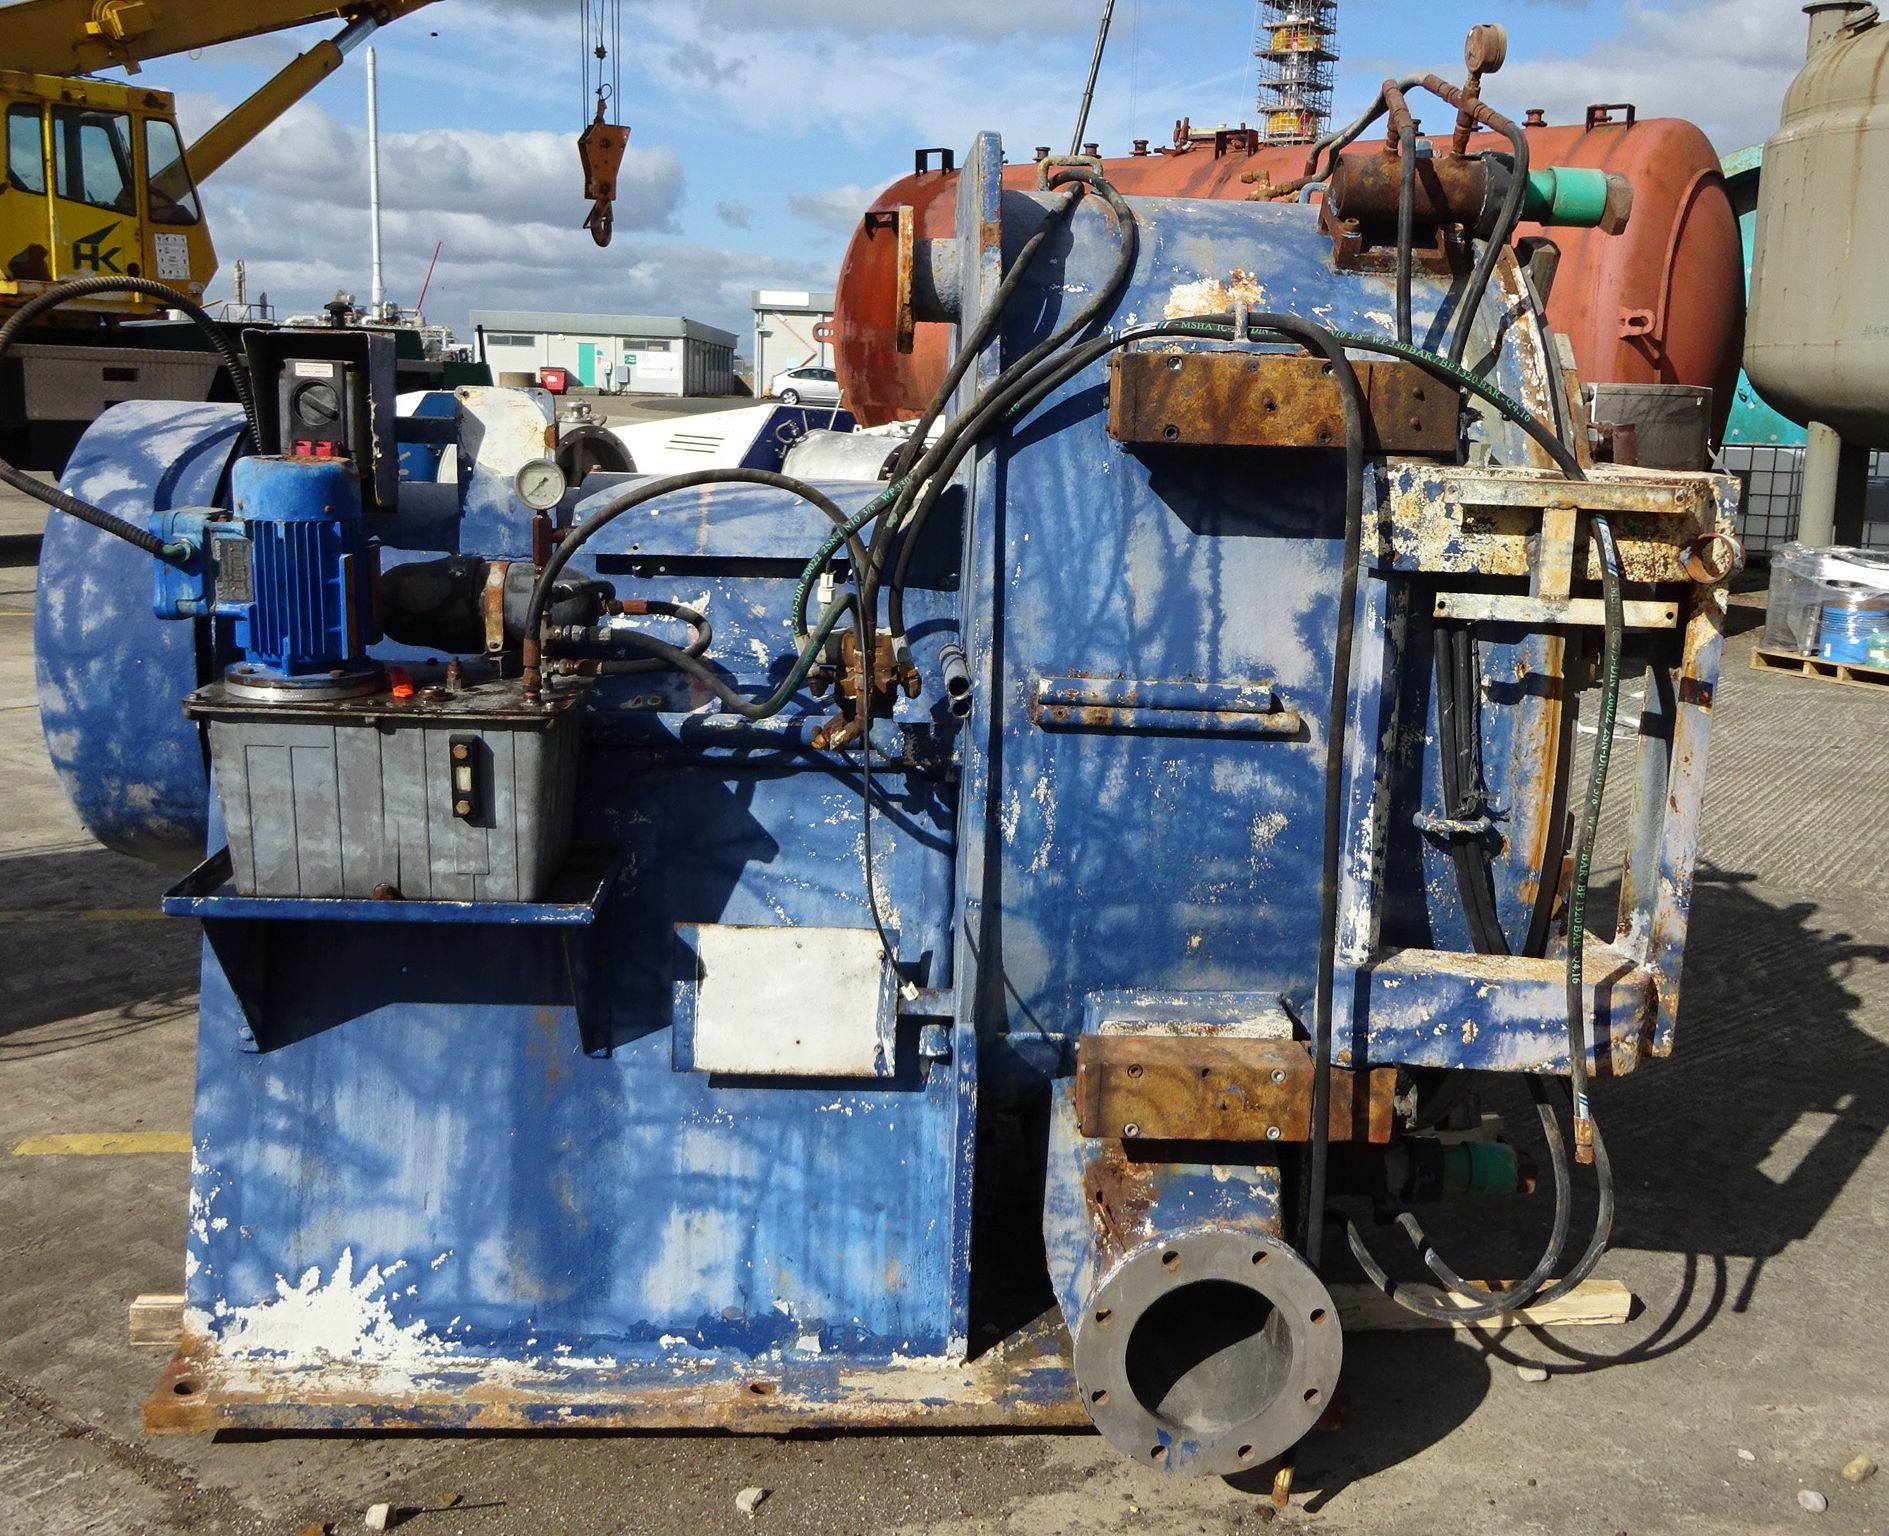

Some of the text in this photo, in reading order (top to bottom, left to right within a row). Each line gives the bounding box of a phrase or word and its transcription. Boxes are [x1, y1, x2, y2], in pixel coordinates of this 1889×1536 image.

[72, 238, 122, 273] HK
[1181, 321, 1212, 331] MSHA
[1372, 336, 1389, 345] WP
[1478, 380, 1501, 400] BAR
[803, 554, 822, 579] 20022
[880, 487, 897, 502] WP
[1579, 852, 1589, 877] BAR
